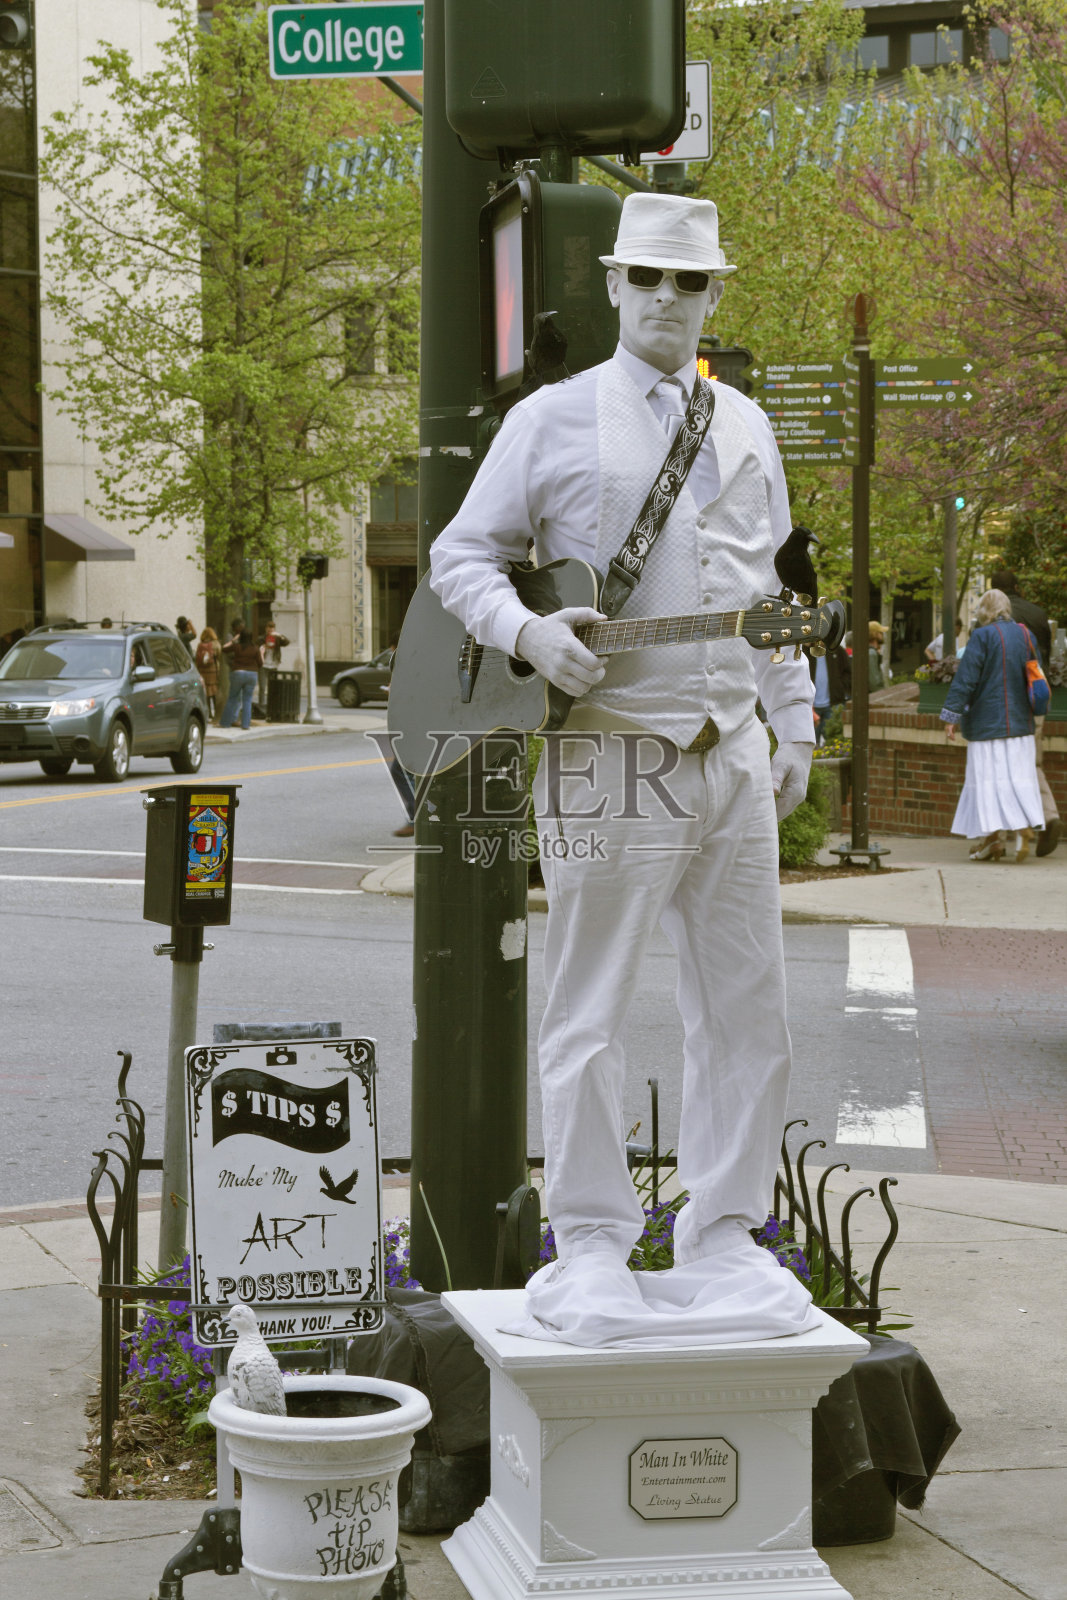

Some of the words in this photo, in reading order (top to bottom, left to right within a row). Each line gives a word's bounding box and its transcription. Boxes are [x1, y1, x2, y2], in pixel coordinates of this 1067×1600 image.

[278, 19, 405, 71] College
[766, 364, 795, 373] Asheville
[797, 363, 833, 373] Community
[766, 373, 790, 381] Theatre
[883, 365, 897, 373] Post
[899, 365, 918, 373] Office
[766, 396, 781, 405] Pack
[783, 396, 805, 406] Square
[806, 396, 821, 404] Park
[883, 393, 898, 401] Wall
[899, 393, 918, 401] Street
[920, 393, 943, 402] Garage
[790, 429, 826, 437] Courthouse
[786, 452, 803, 460] State
[804, 452, 828, 460] Historic
[830, 451, 842, 460] Site
[221, 1090, 238, 1118] $
[246, 1090, 316, 1128] TIPS
[325, 1101, 342, 1128] $
[272, 1166, 298, 1193] My
[239, 1211, 338, 1265] ART
[216, 1267, 363, 1304] POSSIBLE
[257, 1318, 297, 1336] HANK
[301, 1315, 332, 1332] YOU!
[640, 1449, 669, 1469] Man
[672, 1451, 687, 1468] In
[690, 1447, 729, 1467] White
[641, 1475, 726, 1487] Entertainment.com
[303, 1479, 393, 1525] PLEASE
[646, 1494, 681, 1511] Living
[315, 1539, 385, 1577] PHOTO
